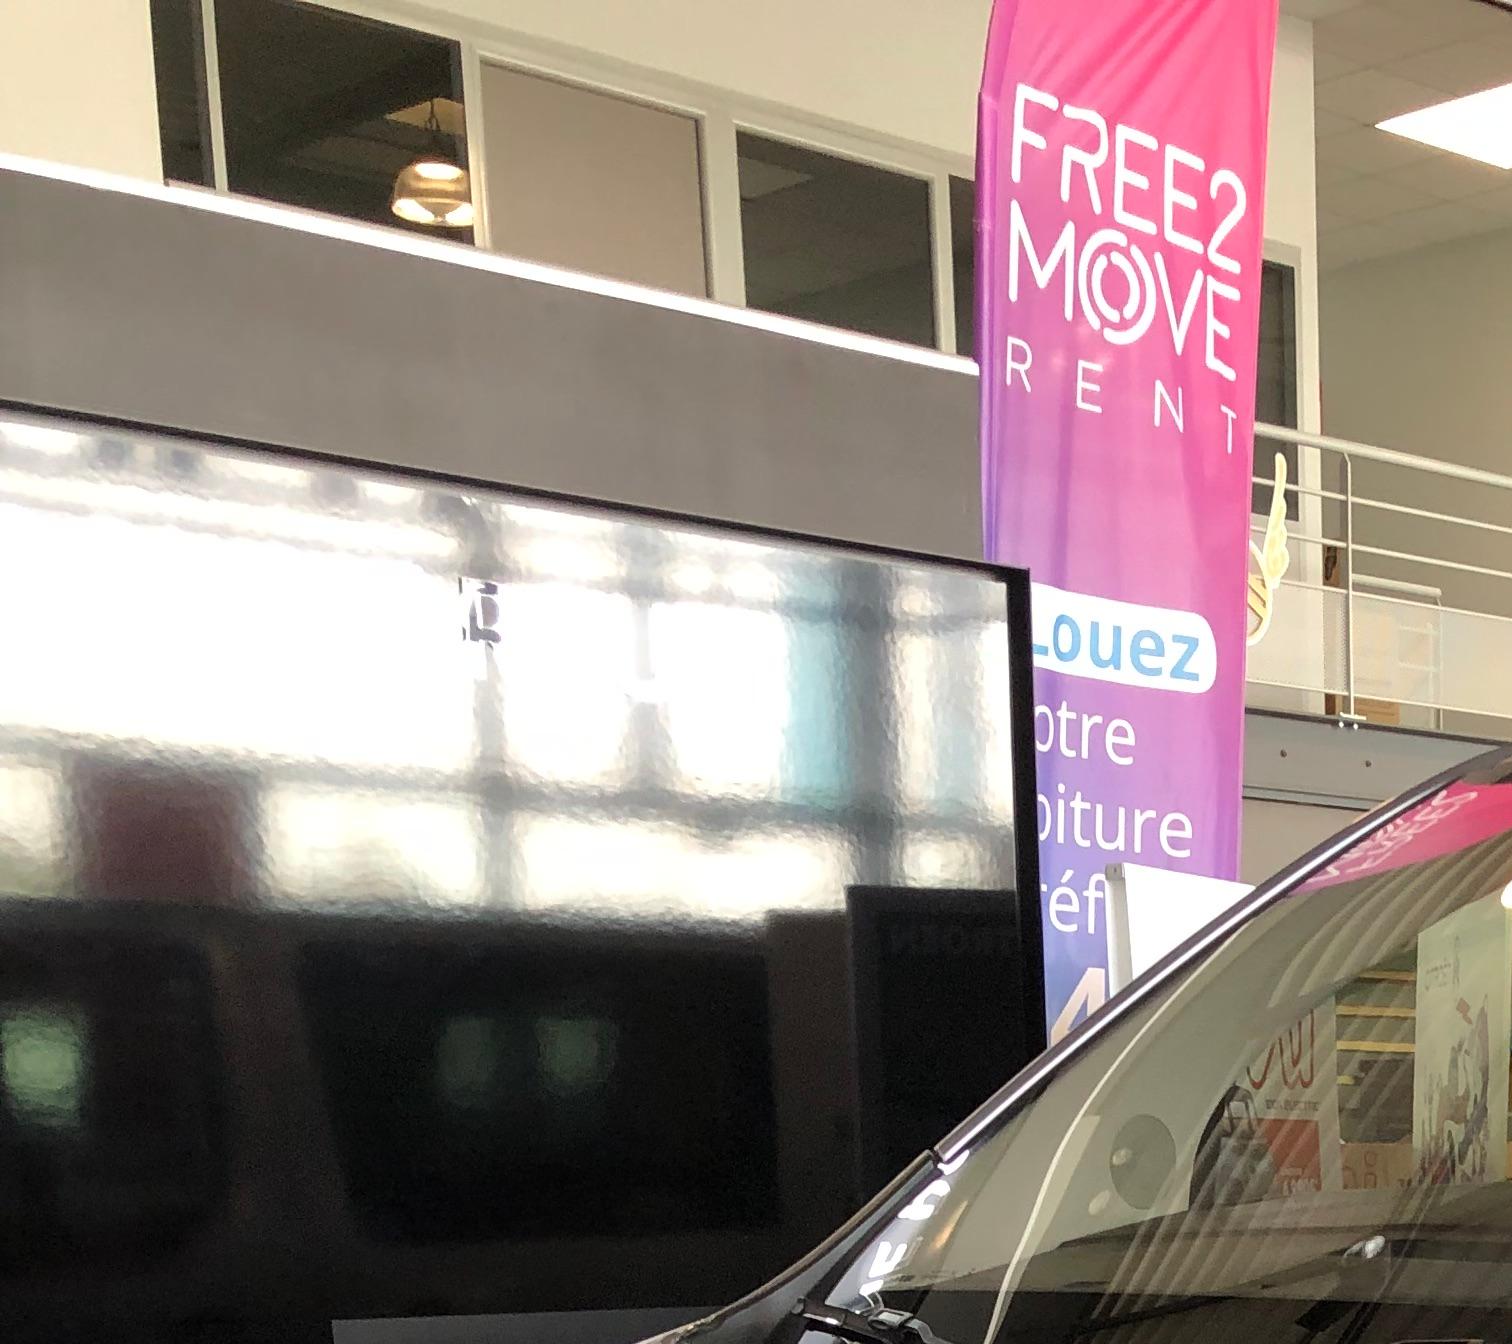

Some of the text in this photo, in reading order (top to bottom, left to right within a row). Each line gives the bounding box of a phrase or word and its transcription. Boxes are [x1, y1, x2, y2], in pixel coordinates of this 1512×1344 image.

[1010, 82, 1248, 275] FREE2
[1008, 198, 1241, 382] MOVE
[1005, 335, 1238, 456] RENT
[1040, 868, 1106, 934] éf
